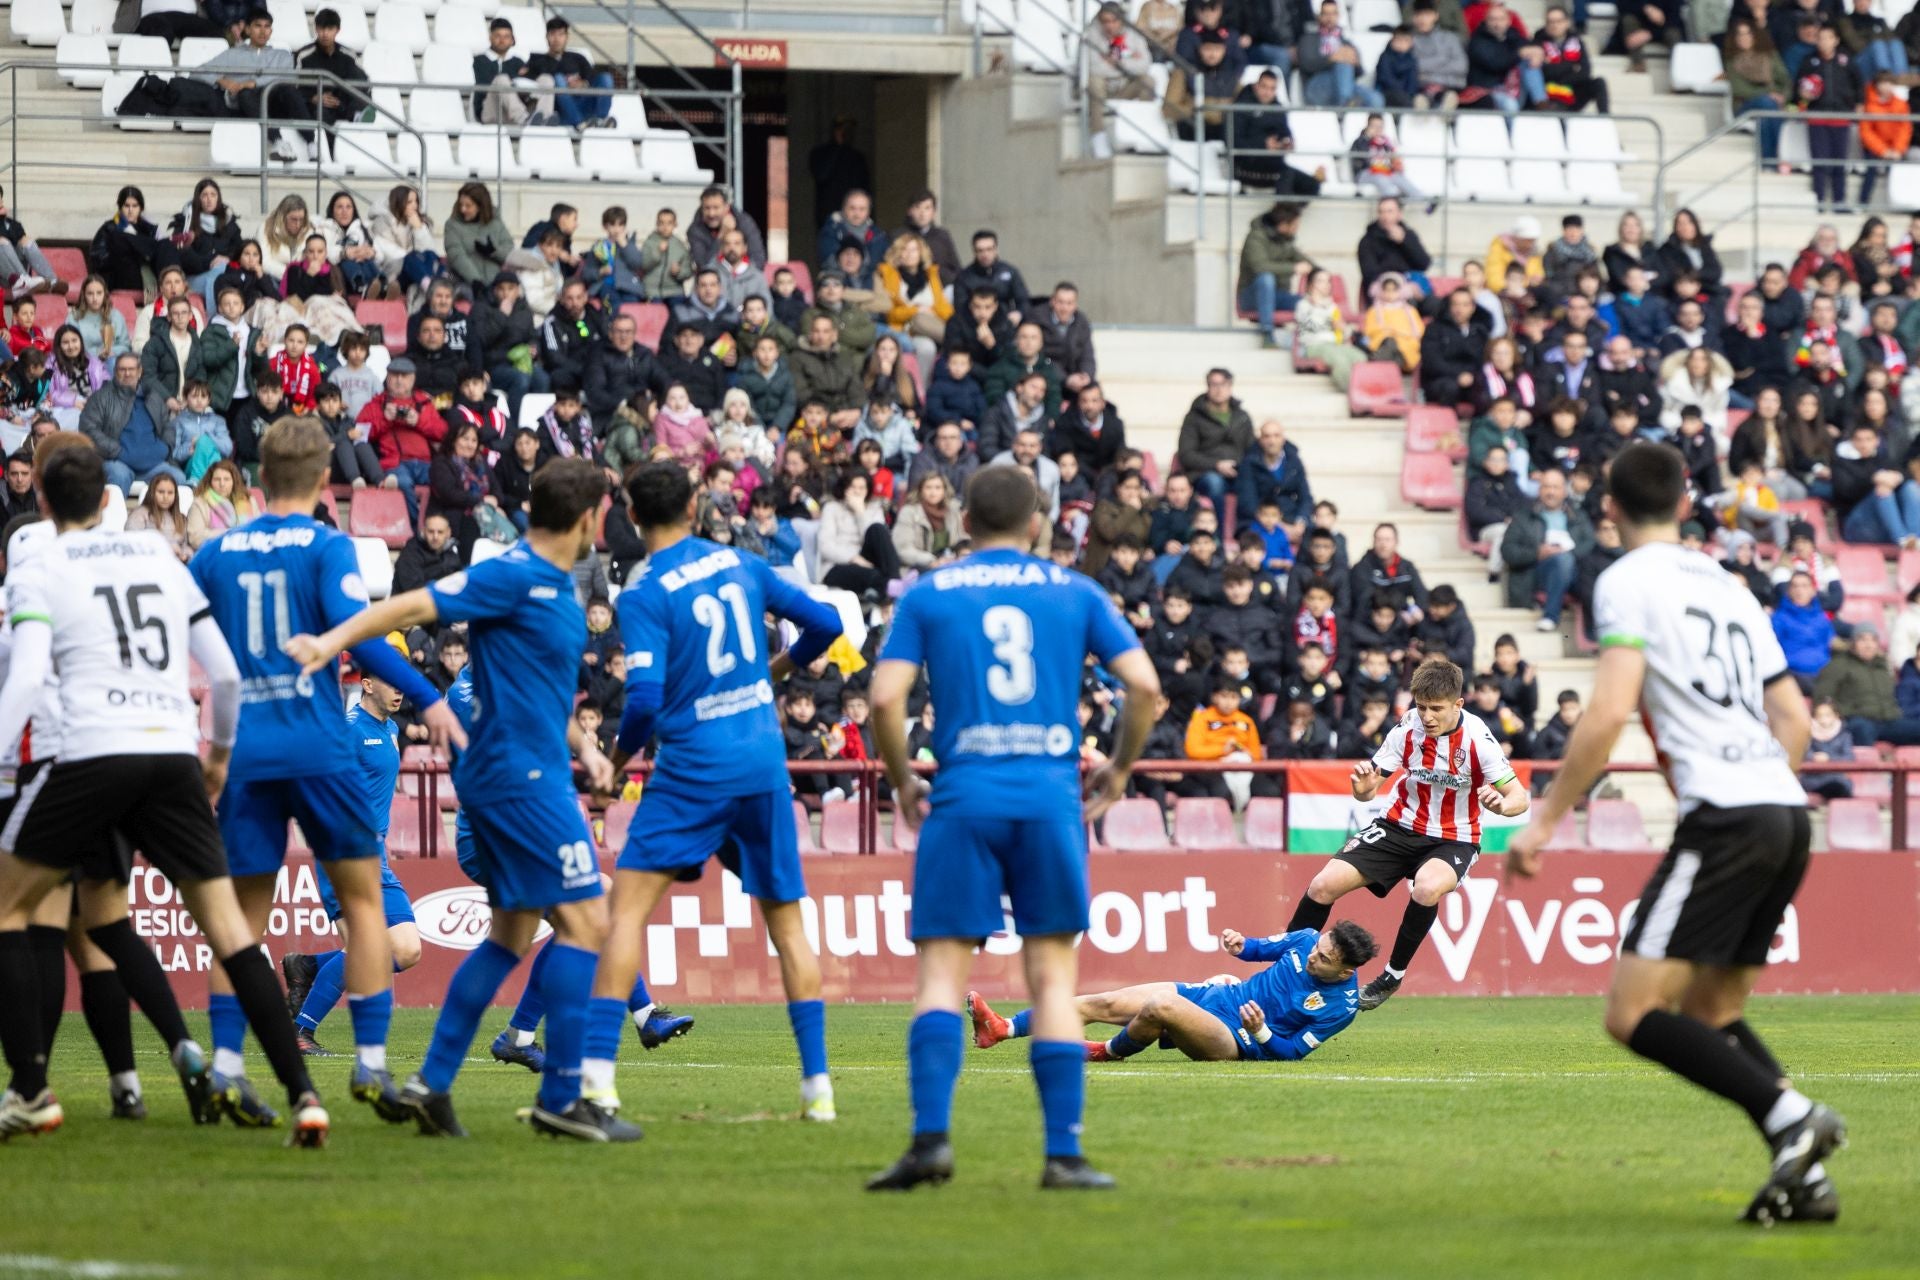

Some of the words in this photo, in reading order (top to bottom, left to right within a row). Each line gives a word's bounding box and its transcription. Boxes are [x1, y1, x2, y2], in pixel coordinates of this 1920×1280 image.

[721, 43, 782, 61] SALIDA
[237, 569, 291, 659] 11
[933, 563, 1048, 591] ENDIKA
[93, 583, 170, 671] 15
[692, 582, 756, 678] 21
[982, 605, 1037, 706] 3
[1685, 606, 1765, 722] 30
[558, 840, 594, 878] 20
